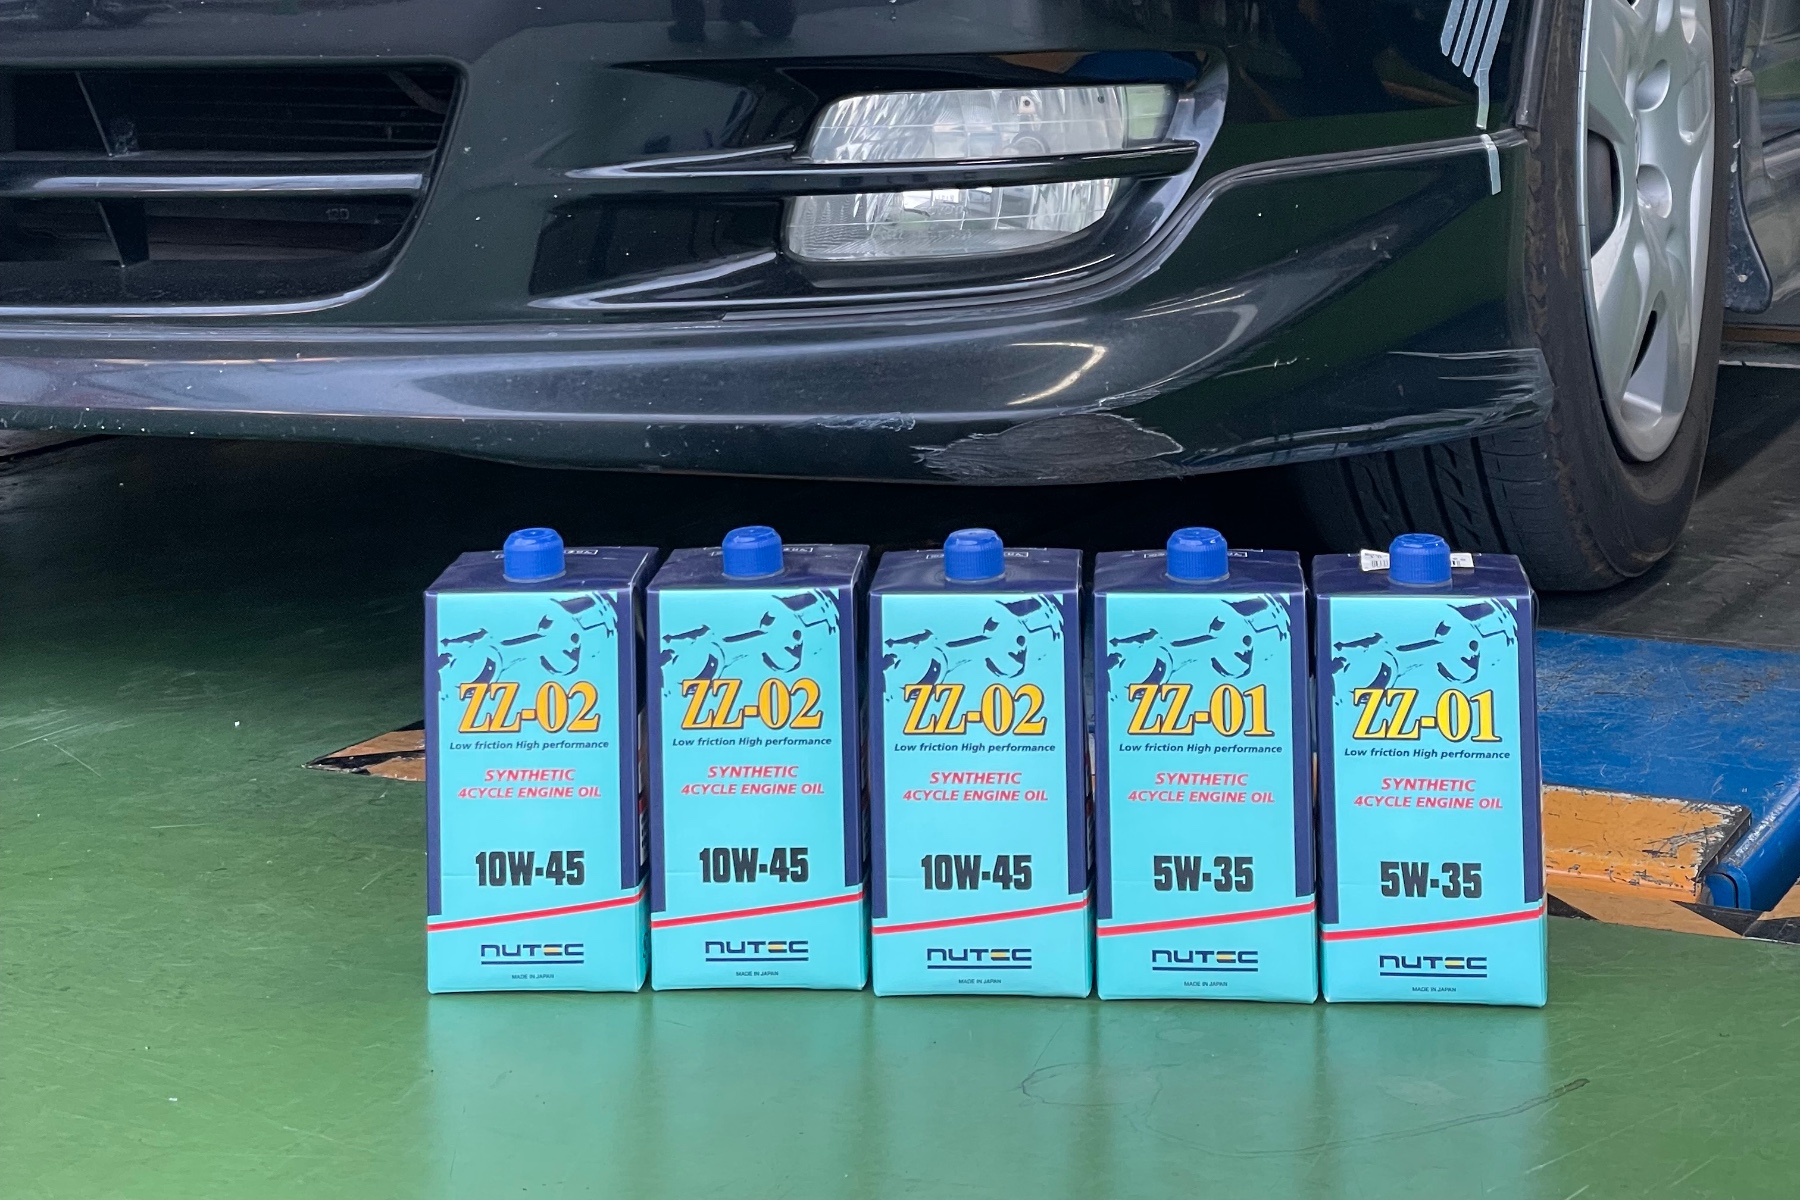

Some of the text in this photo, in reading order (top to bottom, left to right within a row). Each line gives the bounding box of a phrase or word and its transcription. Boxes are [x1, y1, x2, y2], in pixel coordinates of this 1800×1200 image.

[458, 681, 600, 733] ZZ-02
[681, 678, 823, 730] ZZ-02
[903, 683, 1048, 736] ZZ-02
[1127, 683, 1275, 737] ZZ-01
[1353, 688, 1502, 742] ZZ-01
[449, 739, 610, 751] Low friction High performance
[672, 736, 832, 748] Low friction High performance
[894, 742, 1056, 754] Low friction High performance
[1119, 742, 1283, 755] Low friction High performance
[1344, 747, 1511, 760] Low friction High performance
[484, 768, 575, 782] SYNTHETIC
[707, 765, 799, 779] SYNTHETIC
[929, 771, 1023, 785] SYNTHETIC
[1154, 772, 1249, 787] SYNTHETIC
[1381, 777, 1477, 793] SYNTHETIC
[457, 786, 602, 799] 4CYCLE ENGINE OIL
[680, 783, 825, 795] 4CYCLE ENGINE OIL
[902, 789, 1049, 802] 4CYCLE ENGINE OIL
[1127, 790, 1275, 803] 4CYCLE ENGINE OIL
[1353, 795, 1503, 810] 4CYCLE ENGINE OIL
[476, 851, 584, 886] 10W-45
[700, 848, 808, 883] 10W-45
[921, 855, 1032, 890] 10W-45
[1154, 855, 1253, 892] 5W-35
[1381, 861, 1482, 898] 5W-35
[481, 944, 584, 957] NUTEC
[705, 941, 808, 954] NUTEC
[927, 949, 1031, 961] NUTEC
[1152, 950, 1258, 963] NUTEC
[1380, 955, 1487, 969] NUTEC
